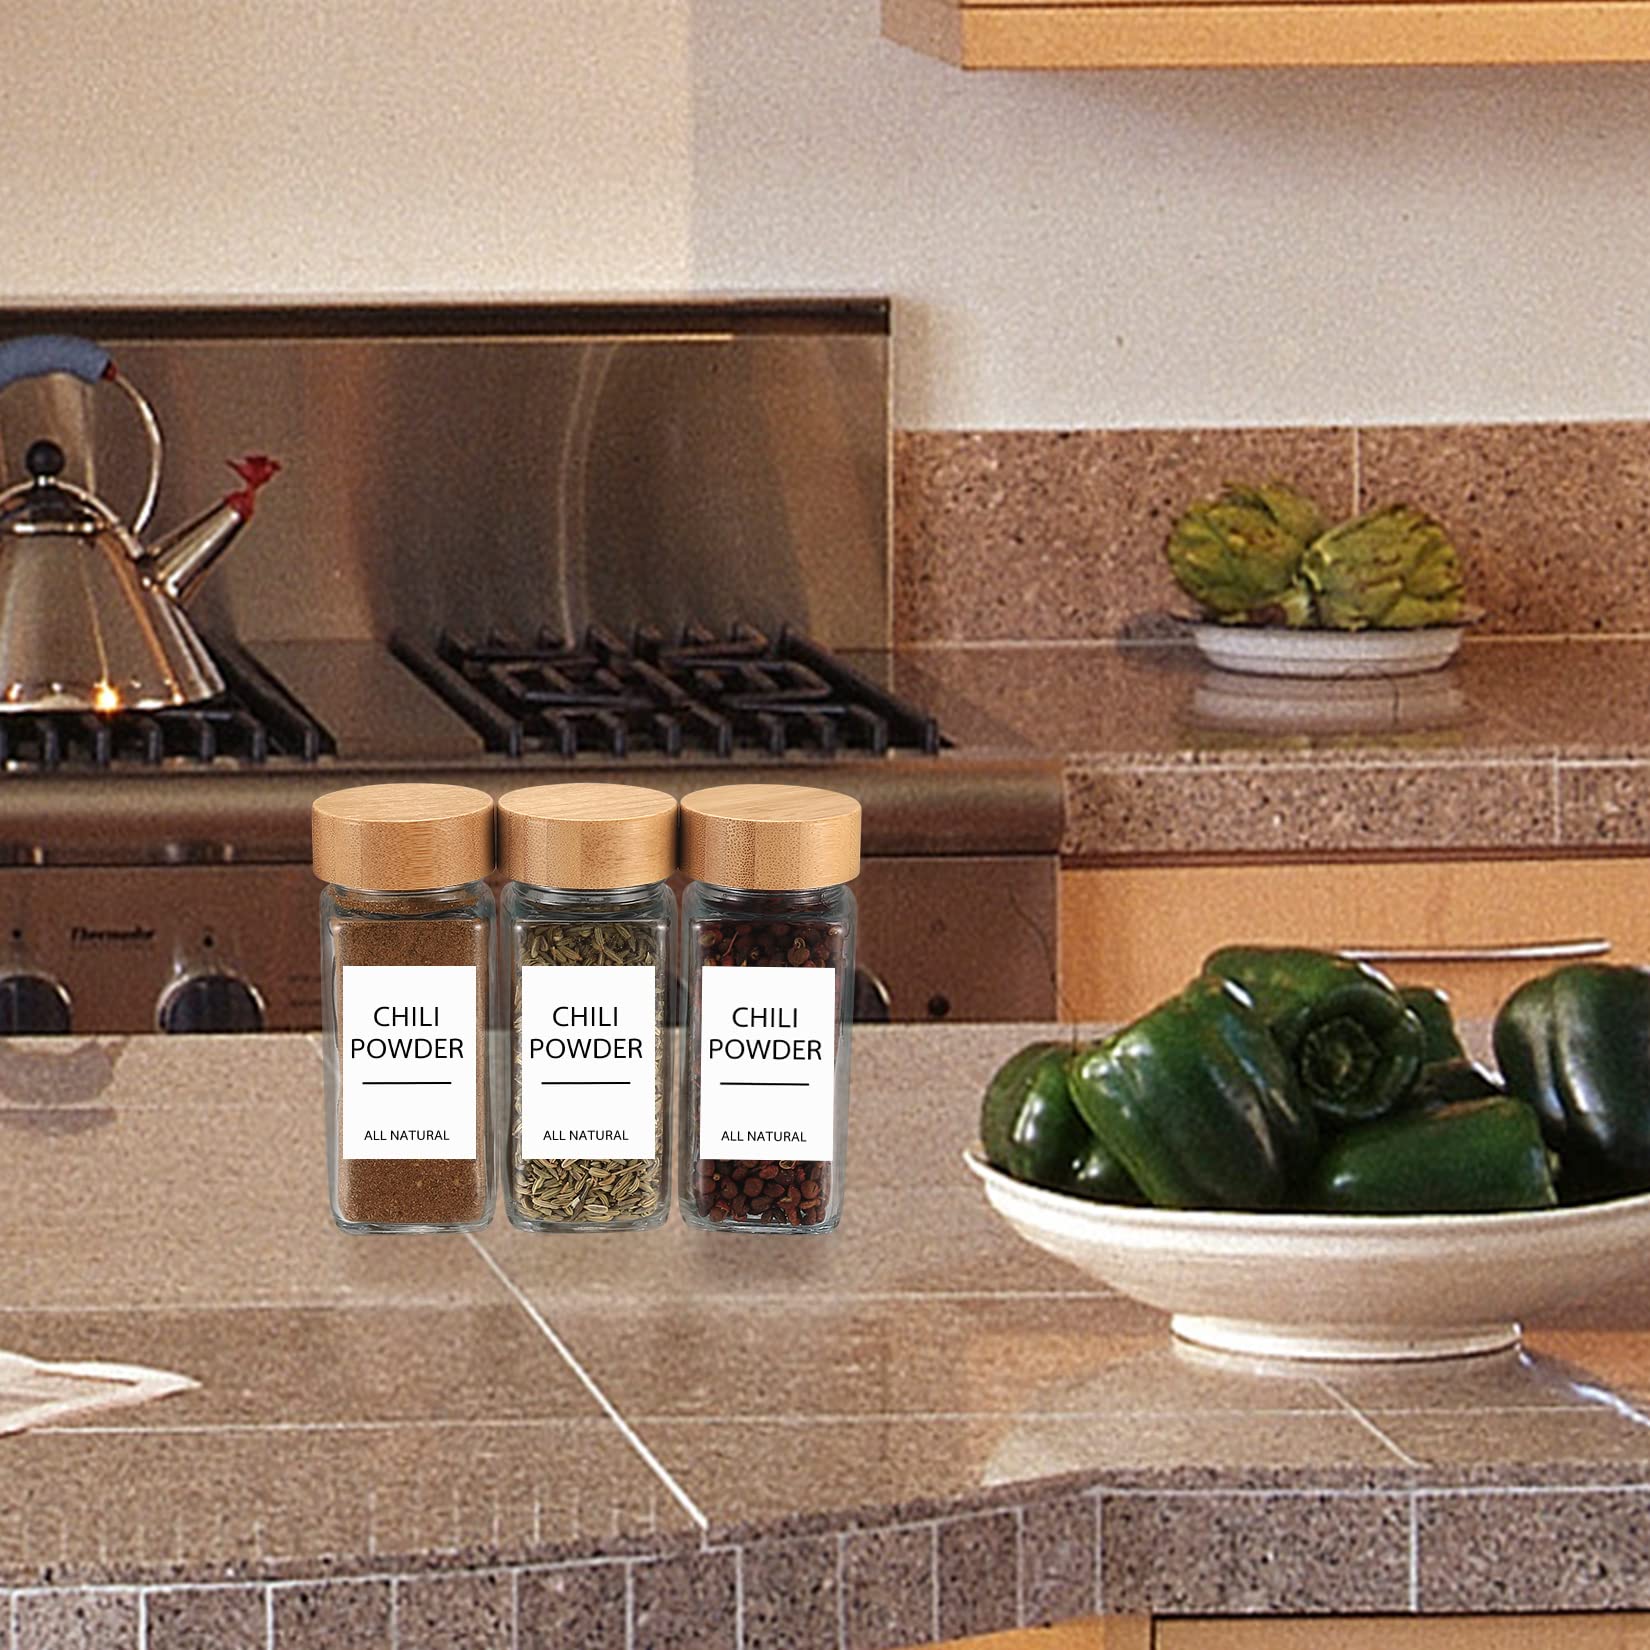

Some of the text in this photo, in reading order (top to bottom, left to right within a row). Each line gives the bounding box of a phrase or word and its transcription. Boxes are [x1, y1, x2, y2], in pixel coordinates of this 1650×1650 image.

[373, 1006, 439, 1027] CHILI
[552, 1006, 618, 1027] CHILI
[732, 1006, 798, 1028] CHILI
[351, 1037, 464, 1059] POWDER
[530, 1038, 643, 1059] POWDER
[709, 1038, 822, 1061] POWDER
[364, 1129, 450, 1141] ALL NATURAL
[542, 1129, 629, 1141] ALL NATURAL
[721, 1130, 807, 1143] ALL NATURAL
